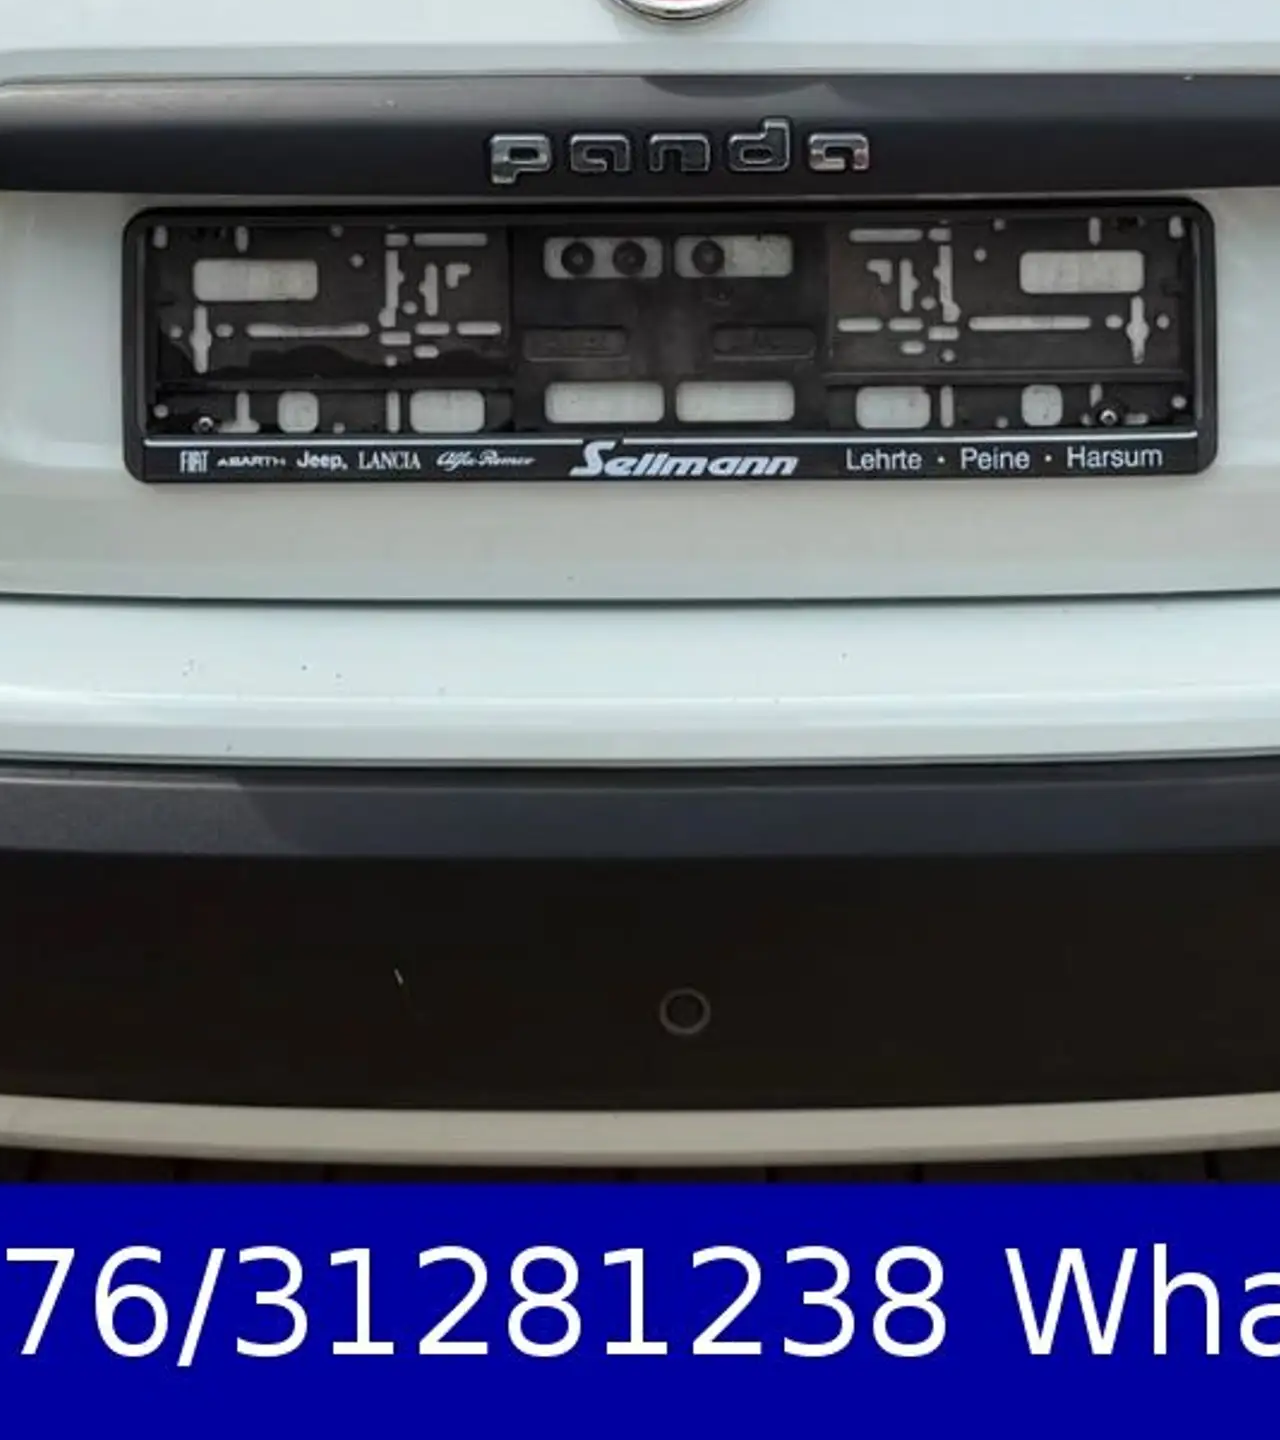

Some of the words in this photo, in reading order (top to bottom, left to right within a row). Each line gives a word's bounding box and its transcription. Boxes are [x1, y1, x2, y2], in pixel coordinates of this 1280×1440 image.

[489, 117, 871, 185] panda
[179, 449, 210, 473] FIAT
[357, 448, 421, 471] LANCIA
[569, 440, 799, 476] Sellmann
[845, 446, 923, 472] Lehrte
[959, 445, 1031, 470] Peine
[1066, 444, 1164, 470] Harsum
